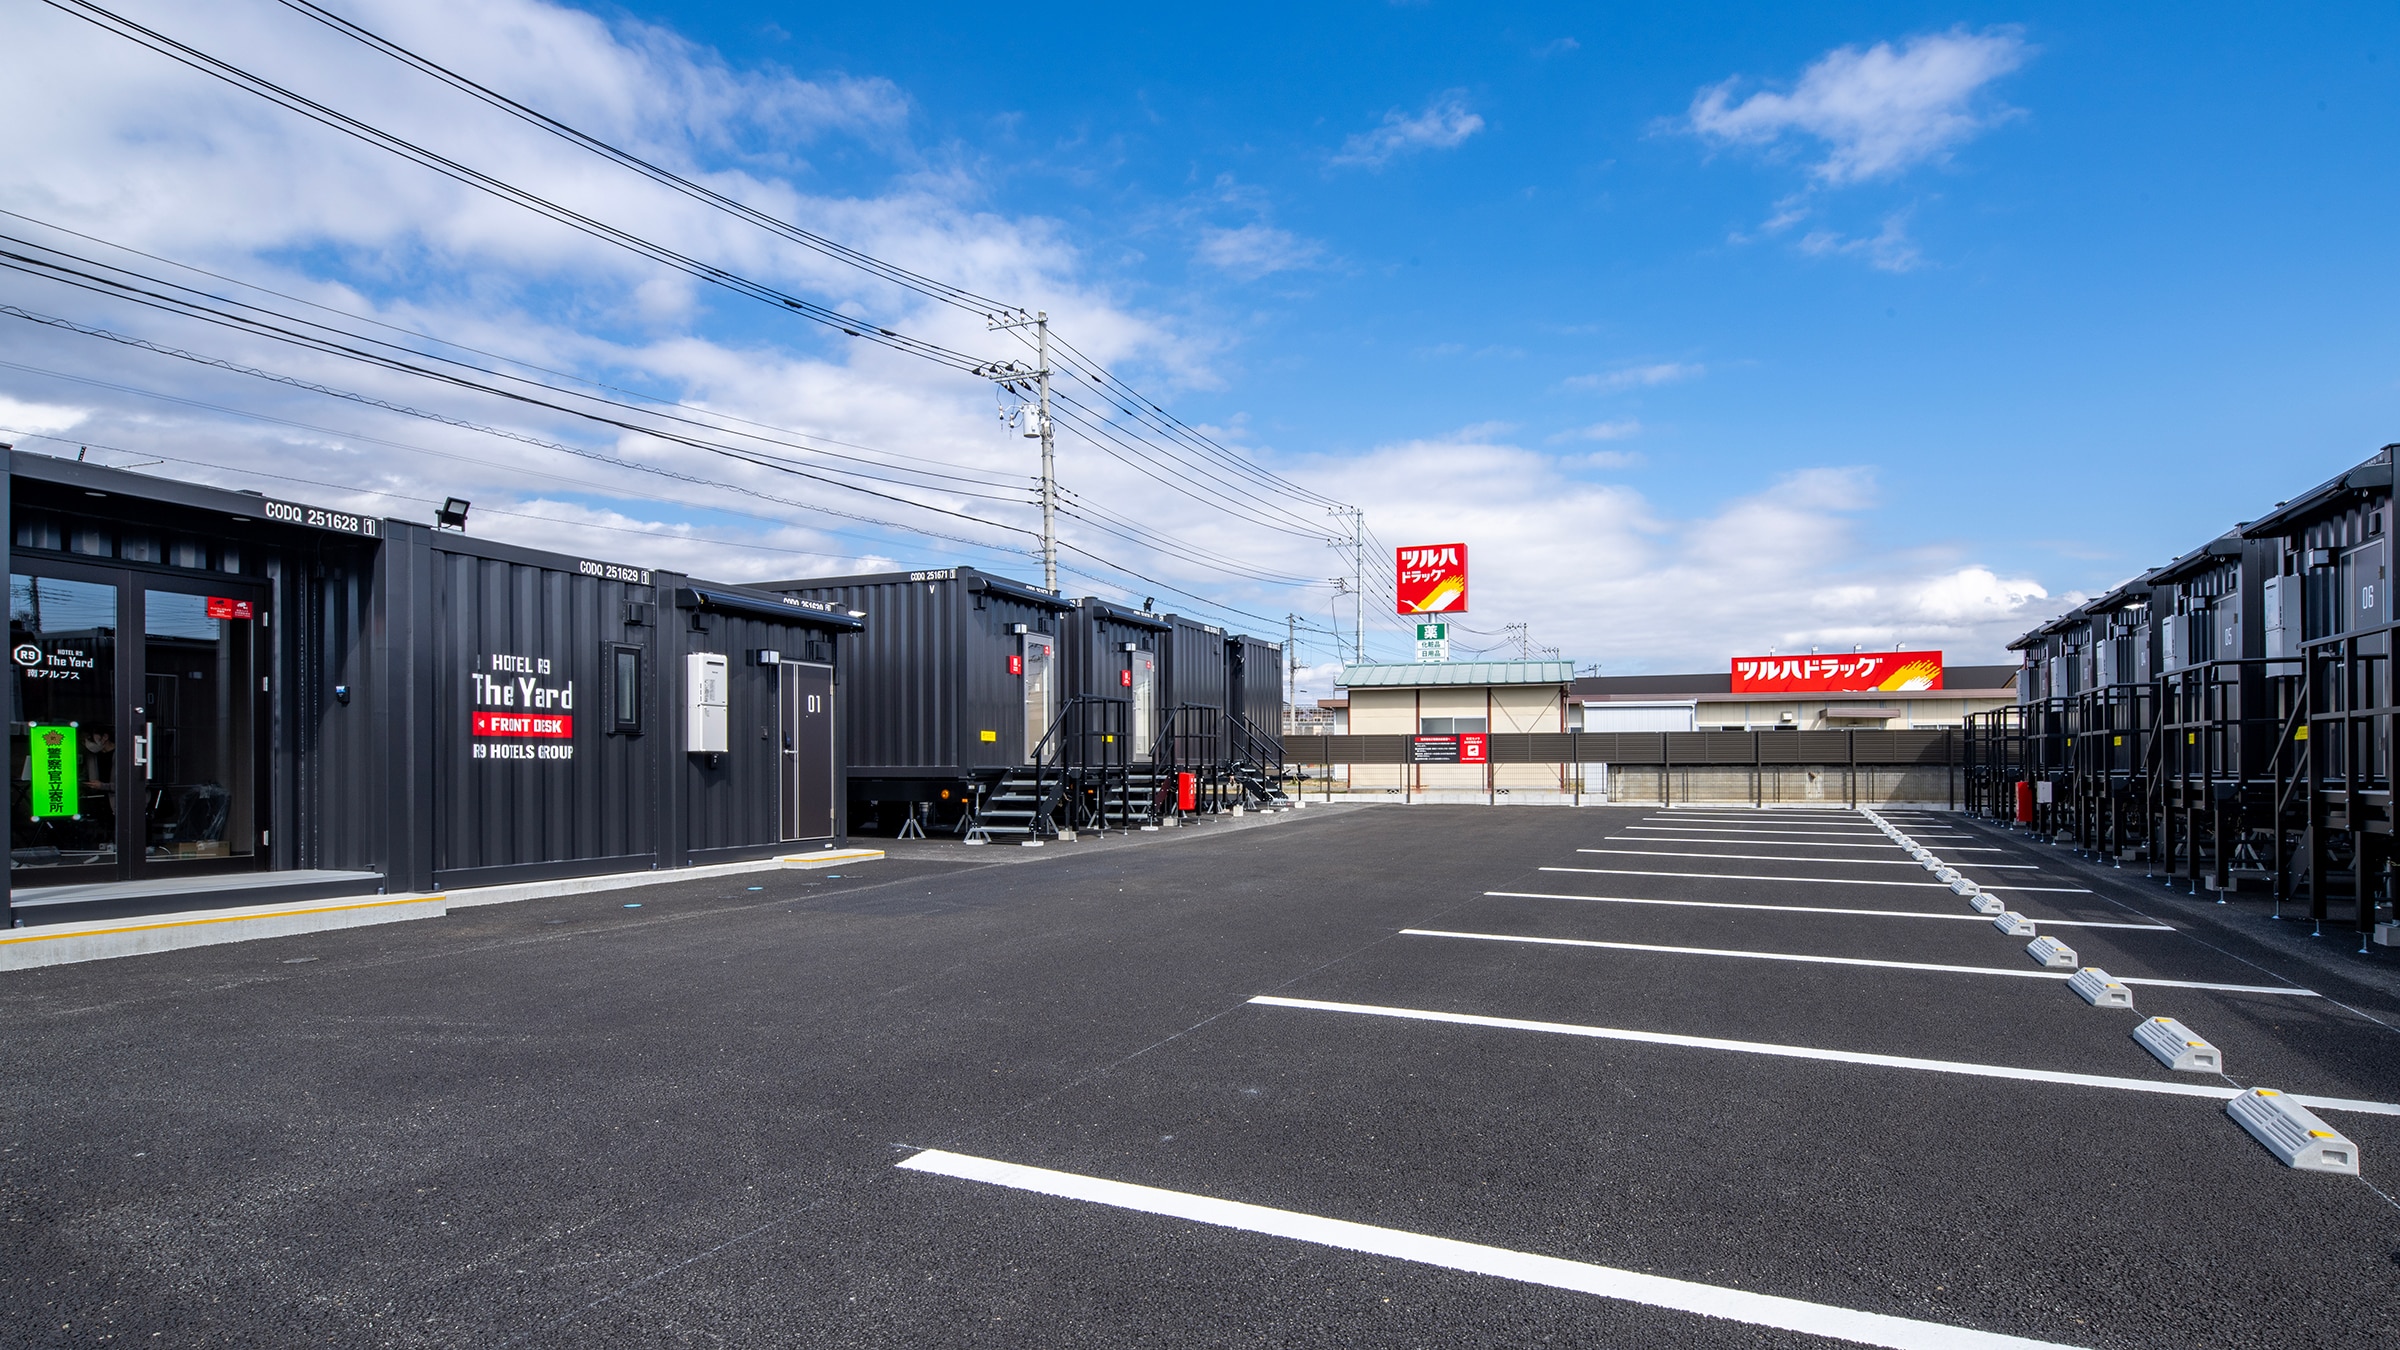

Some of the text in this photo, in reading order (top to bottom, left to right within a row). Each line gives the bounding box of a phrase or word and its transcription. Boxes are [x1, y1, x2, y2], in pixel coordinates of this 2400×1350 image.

[265, 502, 302, 522] CODQ
[308, 510, 358, 532] 251628
[1401, 548, 1458, 569] ツルハ
[580, 561, 603, 577] CODQ
[606, 565, 638, 582] 251629
[1402, 569, 1446, 584] ドラッグ
[2362, 585, 2374, 609] 06
[1424, 625, 1438, 639] 薬
[20, 650, 36, 660] R9
[47, 654, 94, 669] The Yard
[492, 654, 551, 675] HOTEL R9
[1737, 657, 1883, 680] ツルハドラッグ
[472, 673, 573, 709] The Yard
[808, 695, 821, 713] 01
[491, 717, 562, 733] FRONT DESK
[473, 744, 574, 760] R9 HOTELS GROUP
[47, 747, 63, 813] 警察官立寄所
